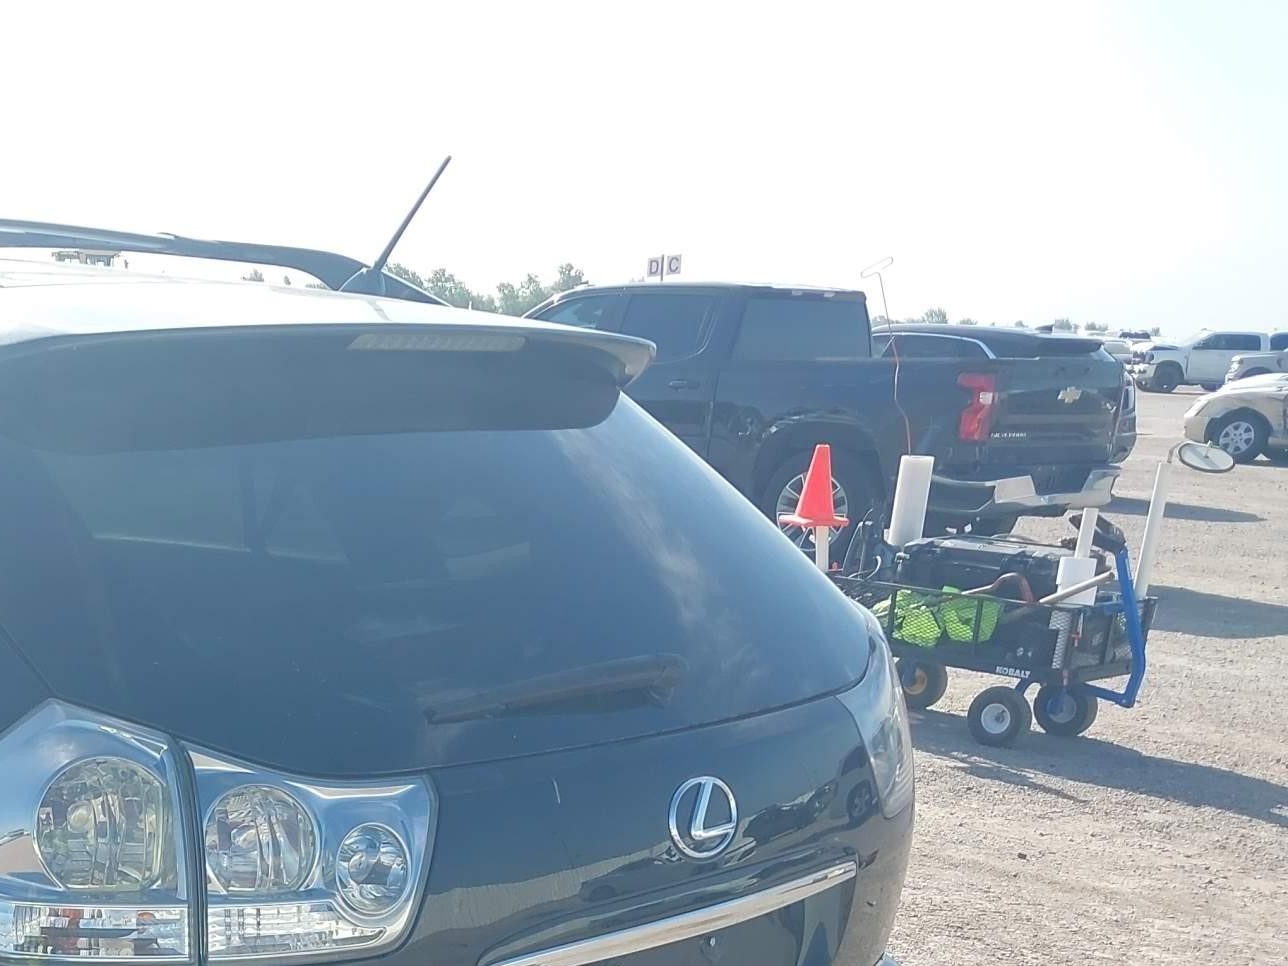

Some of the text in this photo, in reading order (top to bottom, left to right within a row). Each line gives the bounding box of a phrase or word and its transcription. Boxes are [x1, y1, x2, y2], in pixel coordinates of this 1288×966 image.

[649, 259, 659, 275] D
[668, 256, 679, 273] C
[995, 665, 1031, 679] KOBALT
